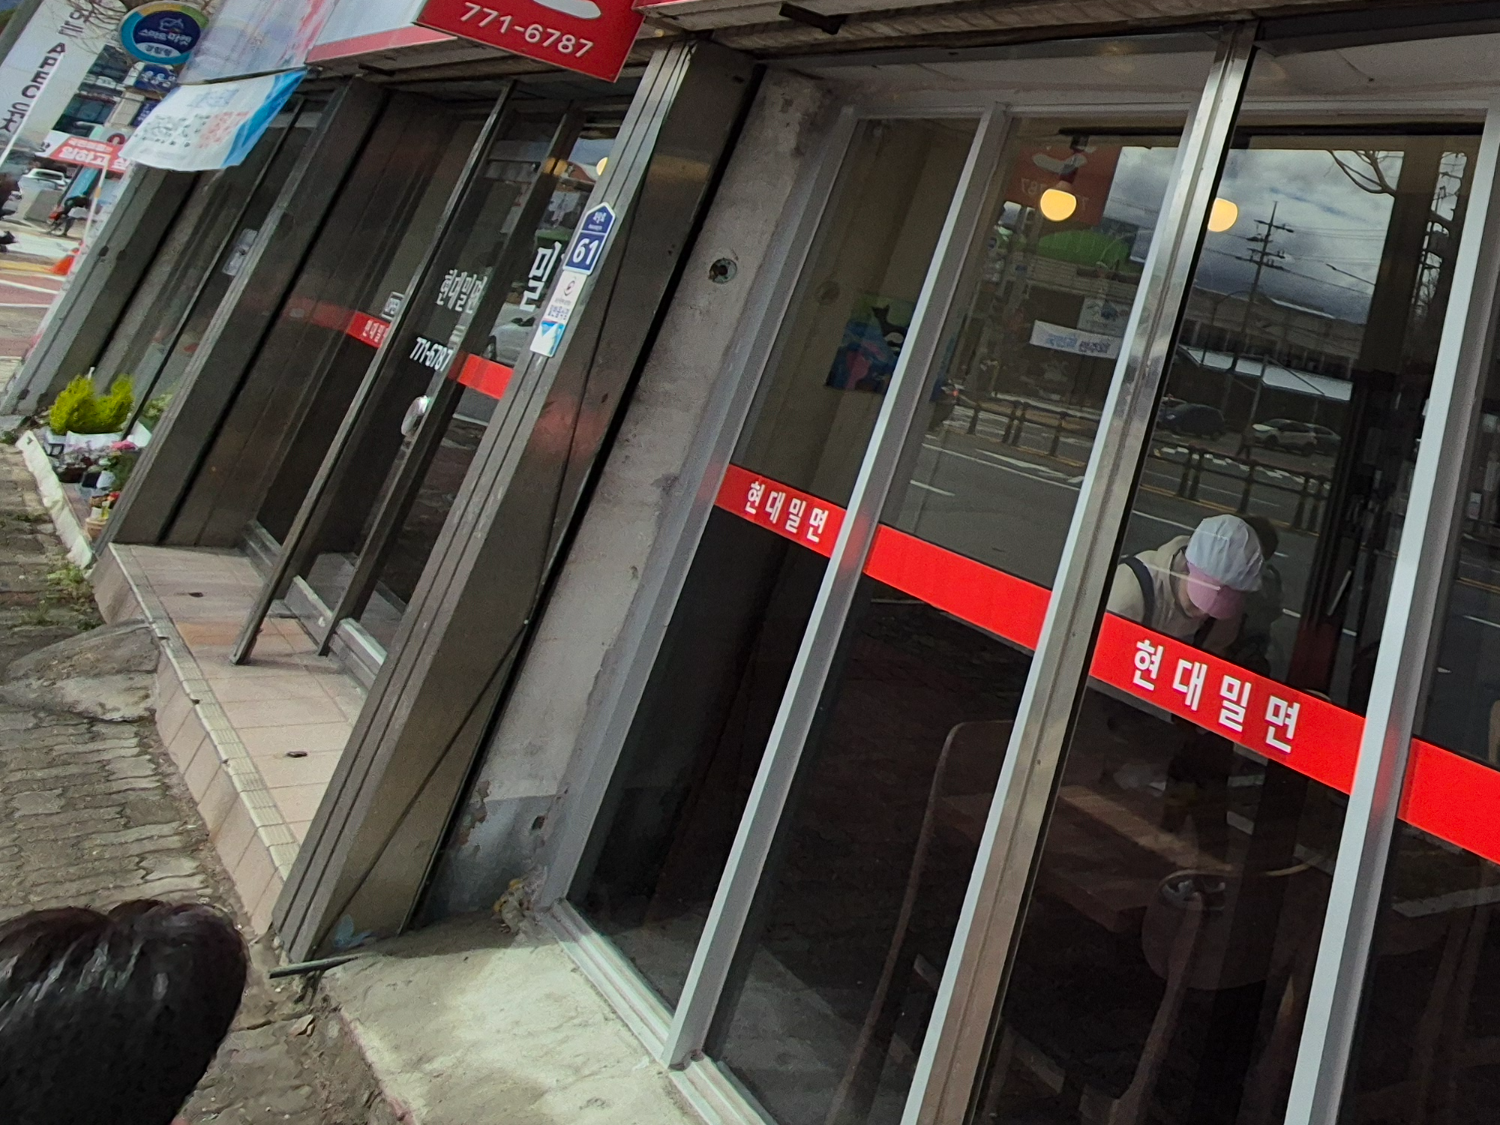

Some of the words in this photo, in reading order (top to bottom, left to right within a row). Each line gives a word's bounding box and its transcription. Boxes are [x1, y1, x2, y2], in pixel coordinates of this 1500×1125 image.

[460, 2, 593, 58] 771-6787
[21, 41, 66, 99] APEC
[519, 241, 564, 312] 밀
[573, 238, 600, 265] 61
[436, 268, 488, 315] 현대밀면
[409, 336, 454, 372] 771-6787
[745, 481, 829, 543] 현대밀면
[1133, 639, 1301, 754] 현대밀면
